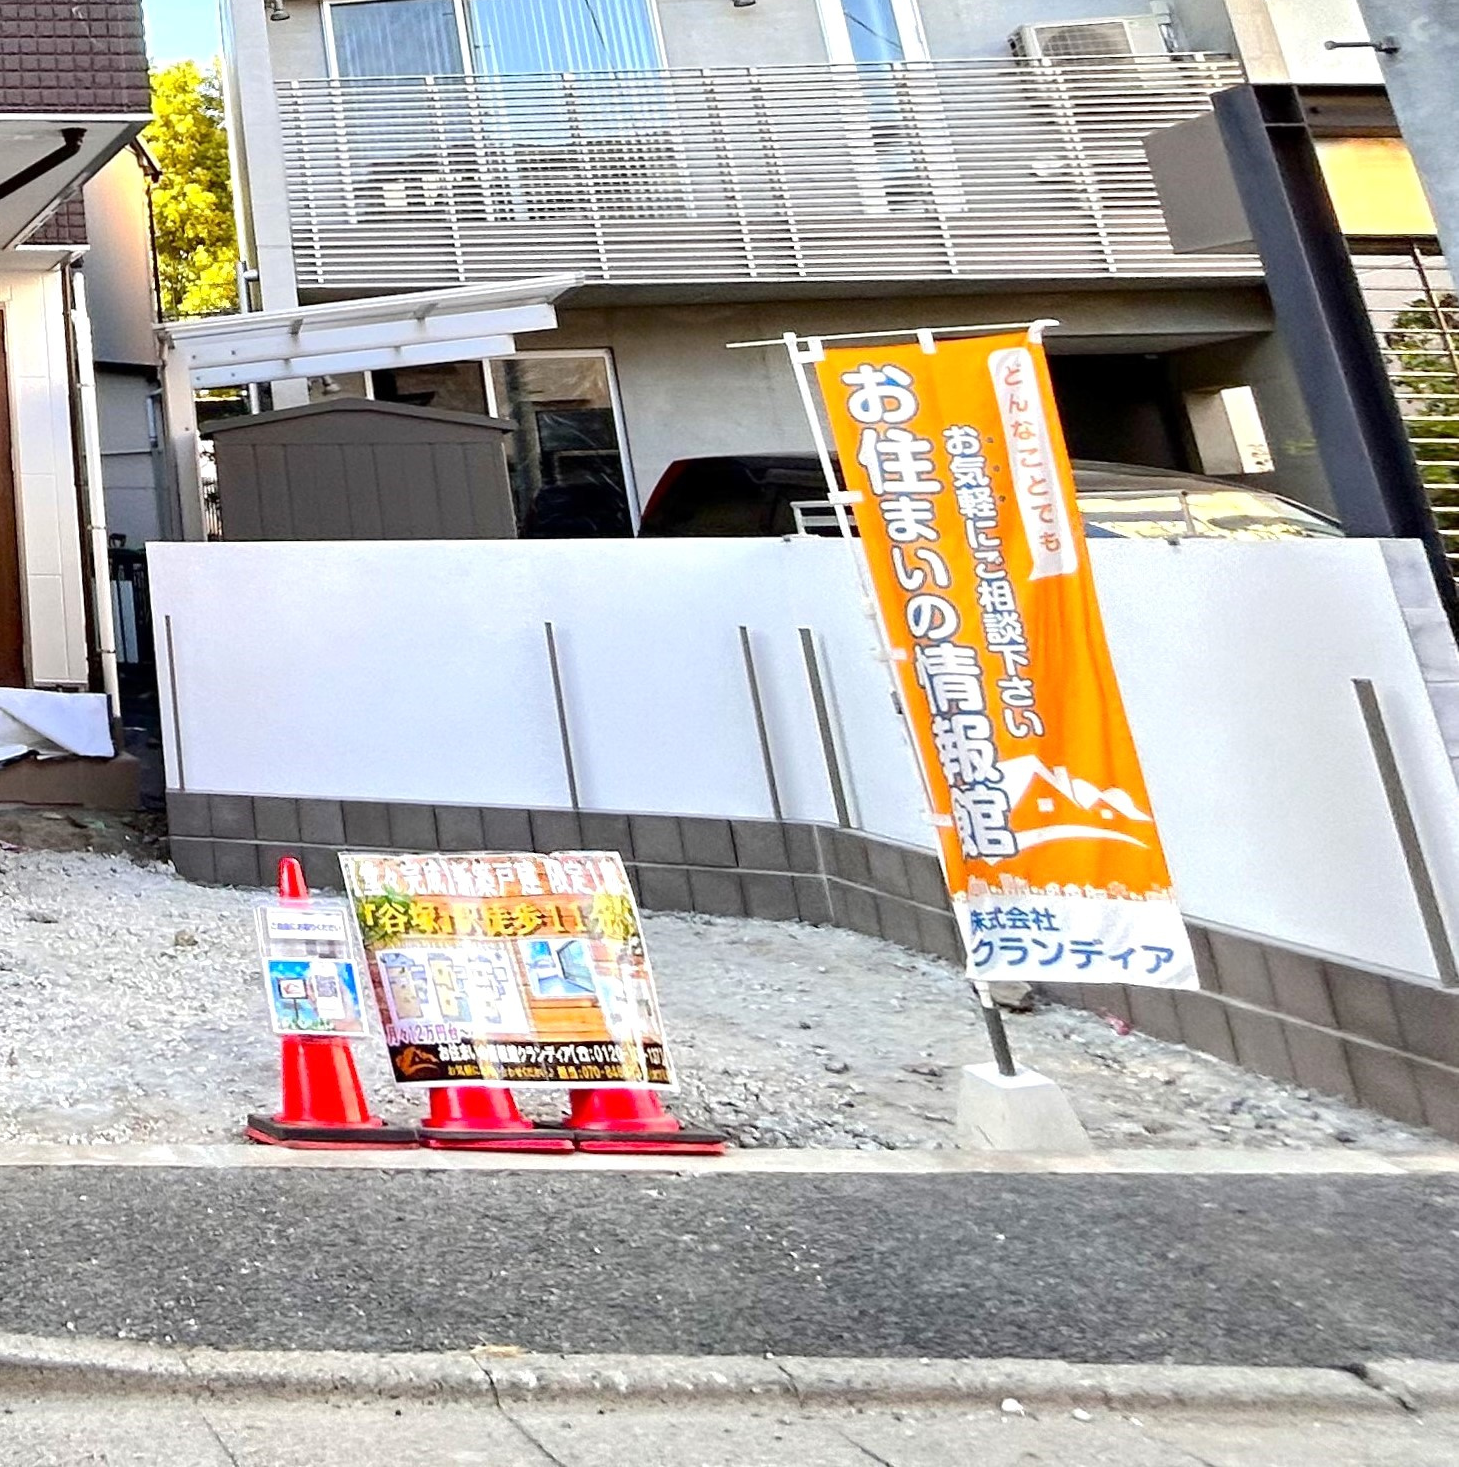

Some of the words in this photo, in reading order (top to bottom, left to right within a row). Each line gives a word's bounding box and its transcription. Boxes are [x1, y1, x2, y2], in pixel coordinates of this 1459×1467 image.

[942, 422, 1044, 739] お気軽にご相談下さい
[1003, 356, 1062, 553] どんなことでも
[840, 362, 1019, 861] お住まいの情報館
[969, 905, 1060, 935] 株式会社
